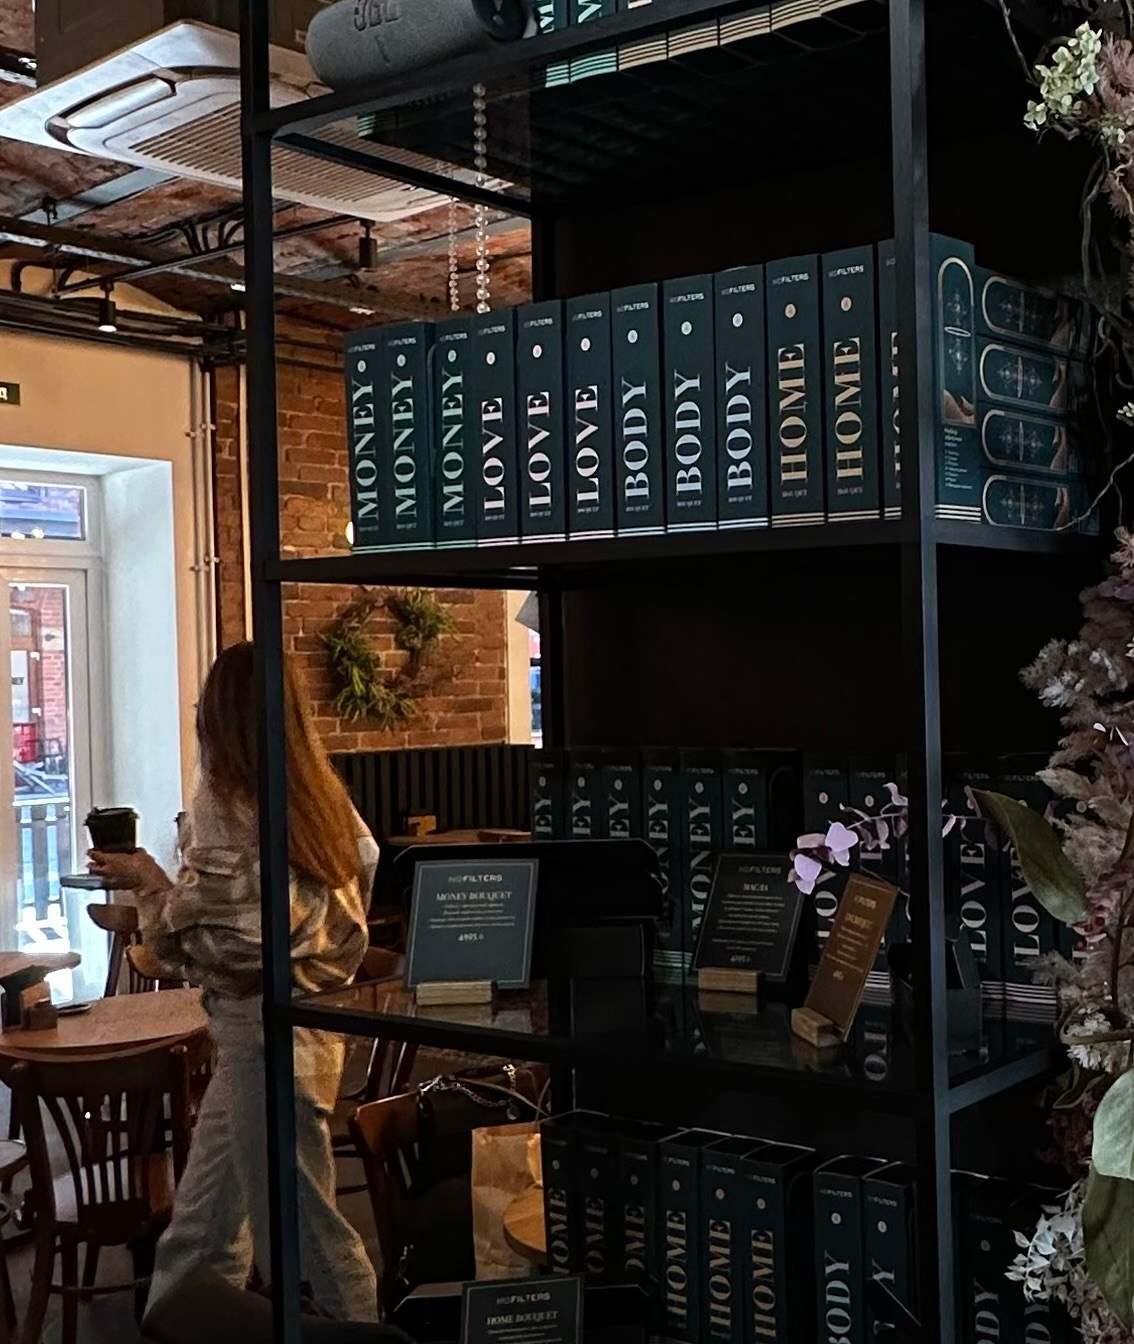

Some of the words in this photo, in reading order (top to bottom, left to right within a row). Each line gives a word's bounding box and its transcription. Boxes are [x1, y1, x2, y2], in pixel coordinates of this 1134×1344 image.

[351, 377, 379, 522] MONEY
[390, 370, 417, 519] MONEY
[441, 367, 465, 516] MONEY
[481, 396, 506, 513] LOVE
[526, 390, 552, 509] LOVE
[575, 384, 600, 504] LOVE
[621, 375, 650, 503] BODY
[673, 368, 703, 496] BODY
[724, 361, 754, 492] BODY
[777, 342, 808, 485] HOME
[833, 336, 864, 483] HOME
[448, 874, 503, 883] NOFILTERS
[665, 1209, 688, 1317] HOME
[708, 1217, 732, 1328] HOME
[750, 1228, 777, 1339] HOME
